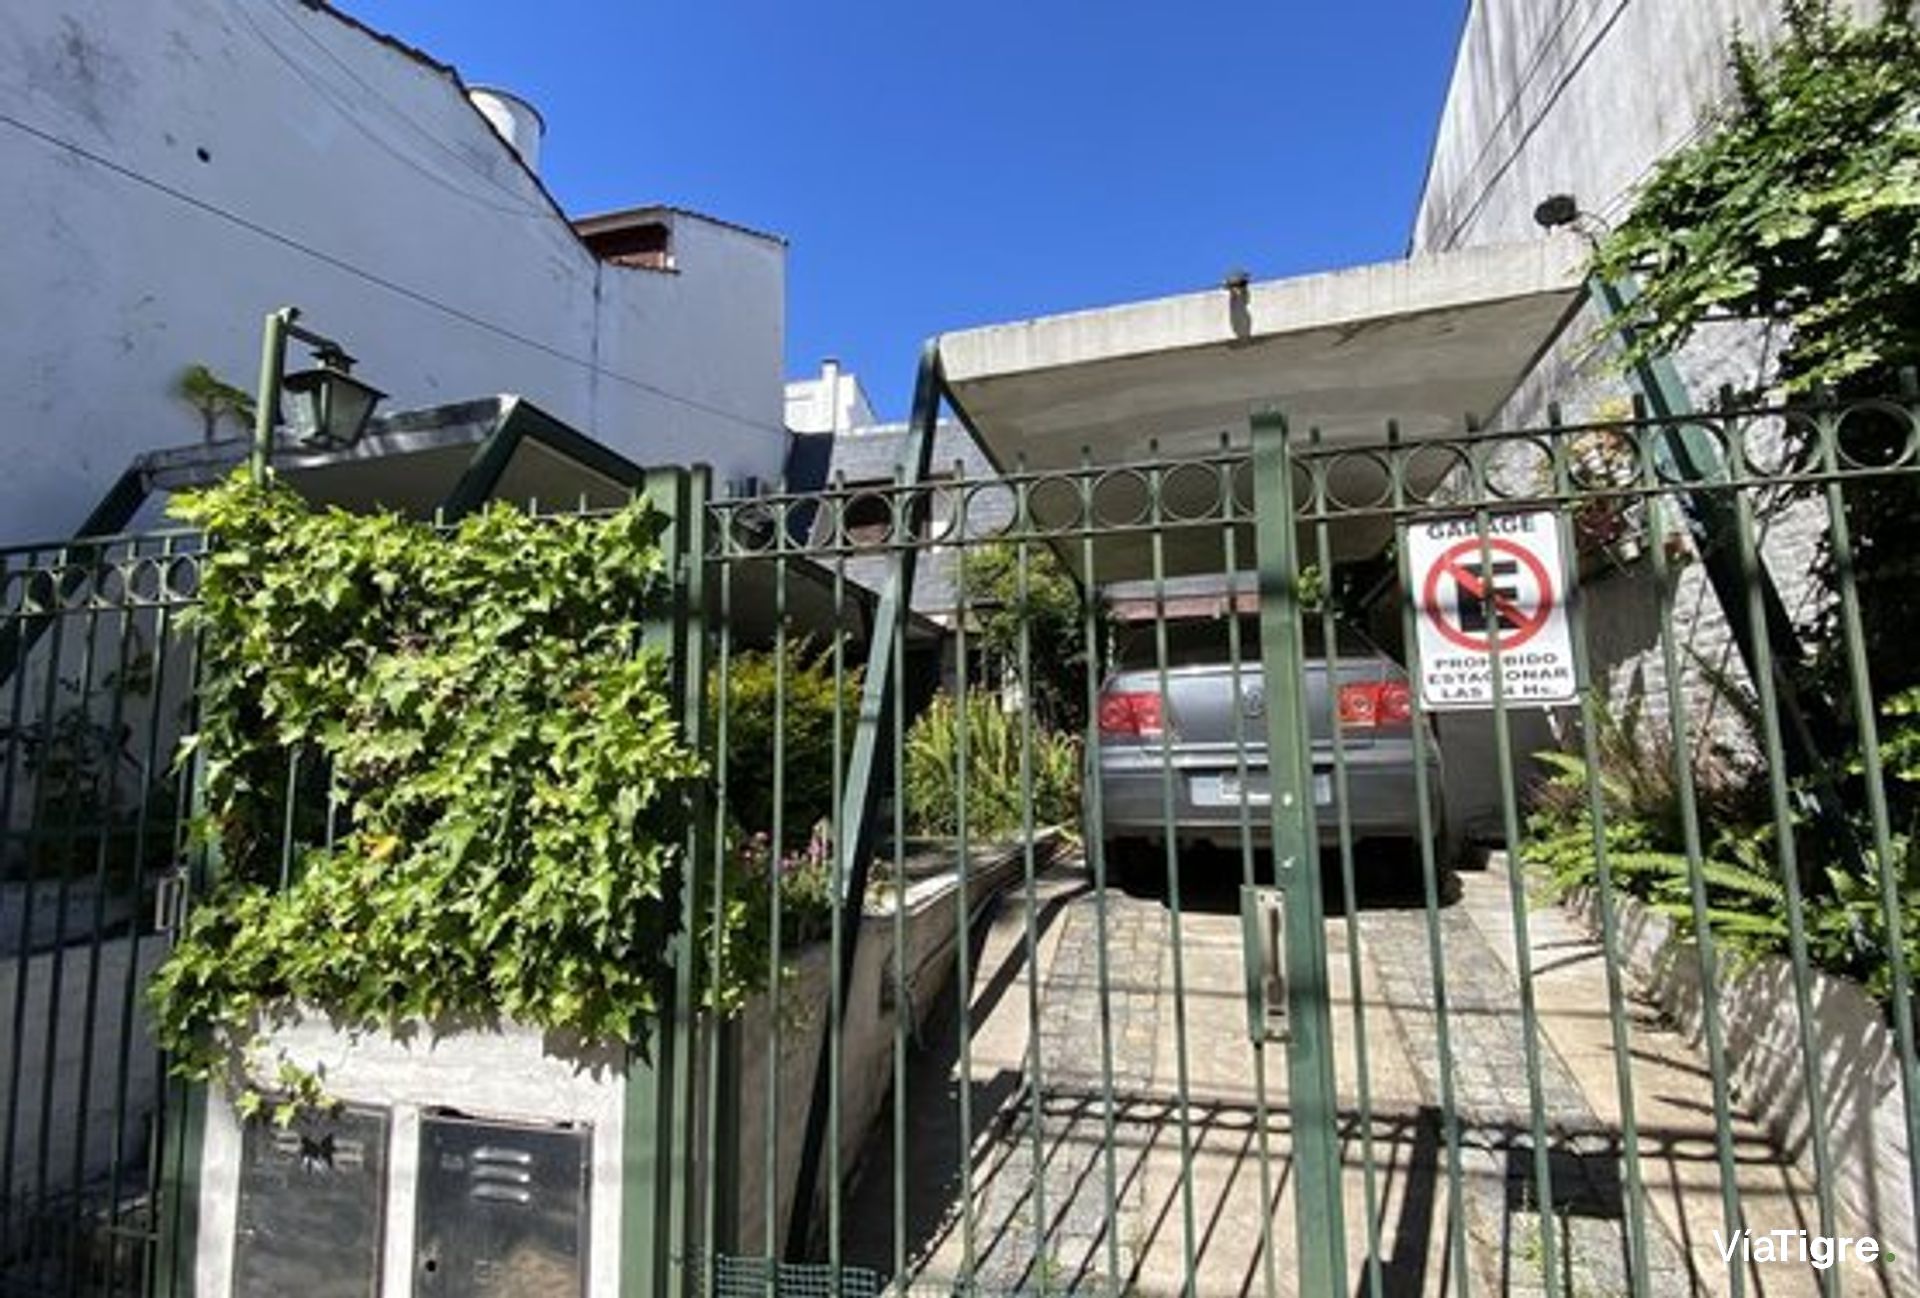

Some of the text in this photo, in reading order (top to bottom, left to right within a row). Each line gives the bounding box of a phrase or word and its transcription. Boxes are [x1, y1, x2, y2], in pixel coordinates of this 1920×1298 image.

[1456, 560, 1518, 632] E
[1435, 654, 1558, 669] PROHBIDO
[1428, 667, 1569, 684] ESTACONAR
[1442, 686, 1482, 698] LAS
